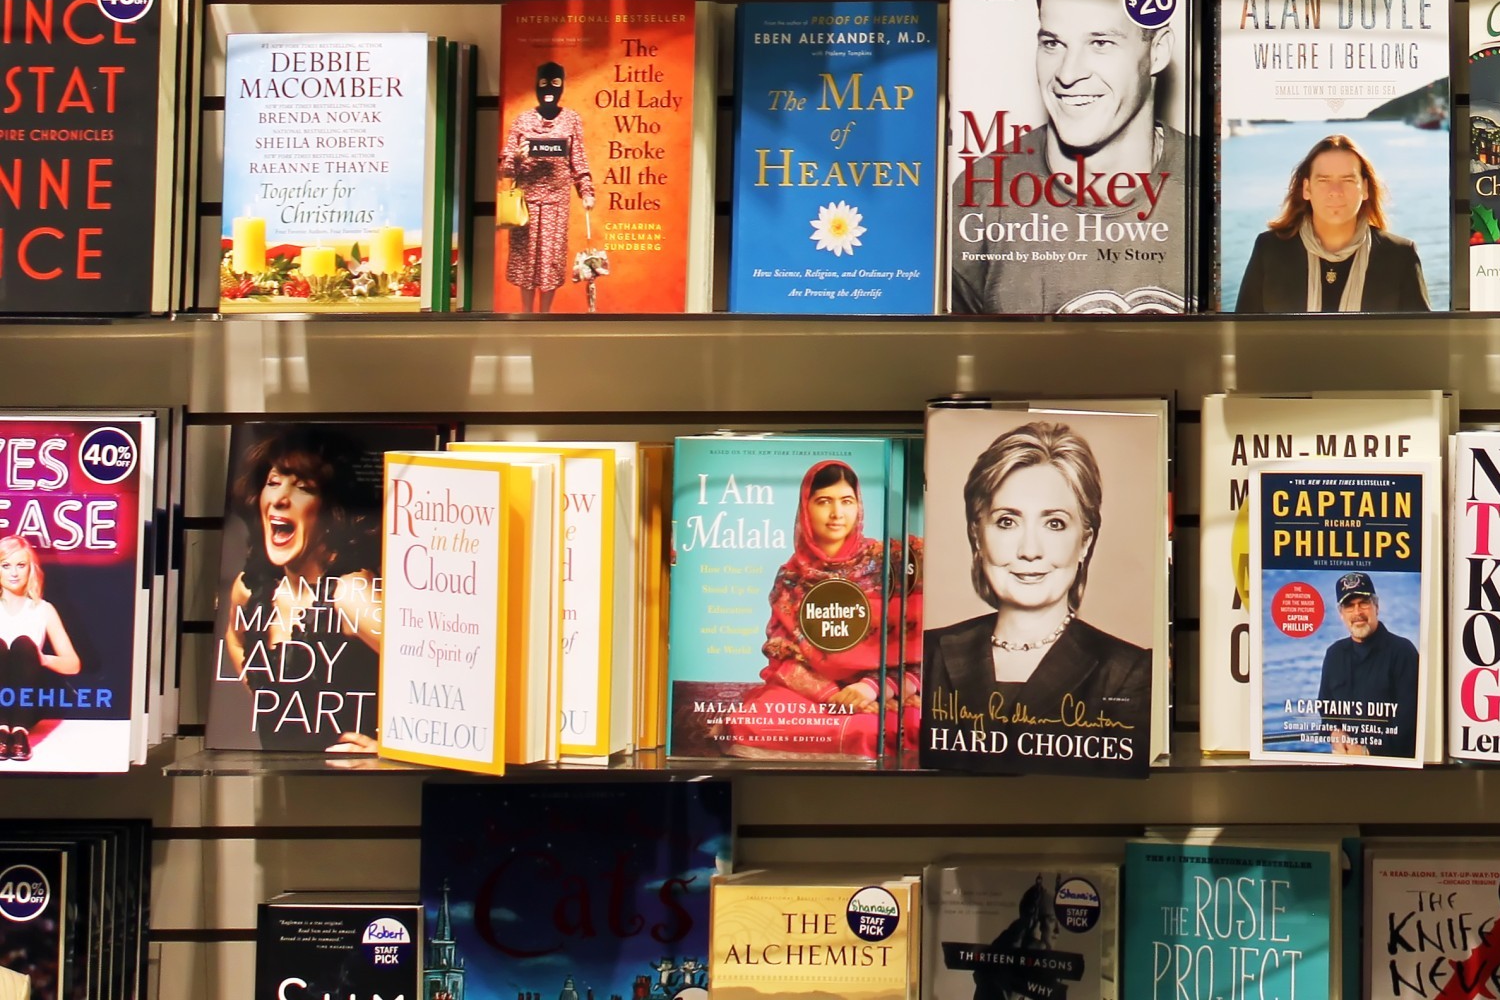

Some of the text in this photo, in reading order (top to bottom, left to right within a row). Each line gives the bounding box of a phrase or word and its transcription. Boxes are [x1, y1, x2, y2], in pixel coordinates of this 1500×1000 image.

[754, 32, 793, 44] EBEN
[271, 51, 370, 73] DEBBIE
[240, 77, 402, 99] MACOMBER
[595, 90, 682, 111] Old Lady
[259, 111, 382, 124] BRENDA NOVAK
[30, 130, 114, 141] CHRONICLES
[959, 110, 1034, 154] Mr.
[754, 149, 922, 187] HEAVEN
[959, 155, 1171, 220] Hockey
[605, 223, 662, 231] CATHARINA
[959, 213, 1168, 243] Gordie Howe
[390, 478, 495, 537] Rainbow
[1273, 492, 1412, 517] CAPTAIN
[683, 515, 787, 552] Malala
[1274, 530, 1410, 559] PHILLIPS
[387, 716, 486, 752] ANGELOU
[725, 717, 777, 725] PATRICIA
[930, 727, 1133, 761] HARD CHOICES
[1194, 876, 1290, 942] ROSIE
[725, 945, 892, 967] ALCHEMIST
